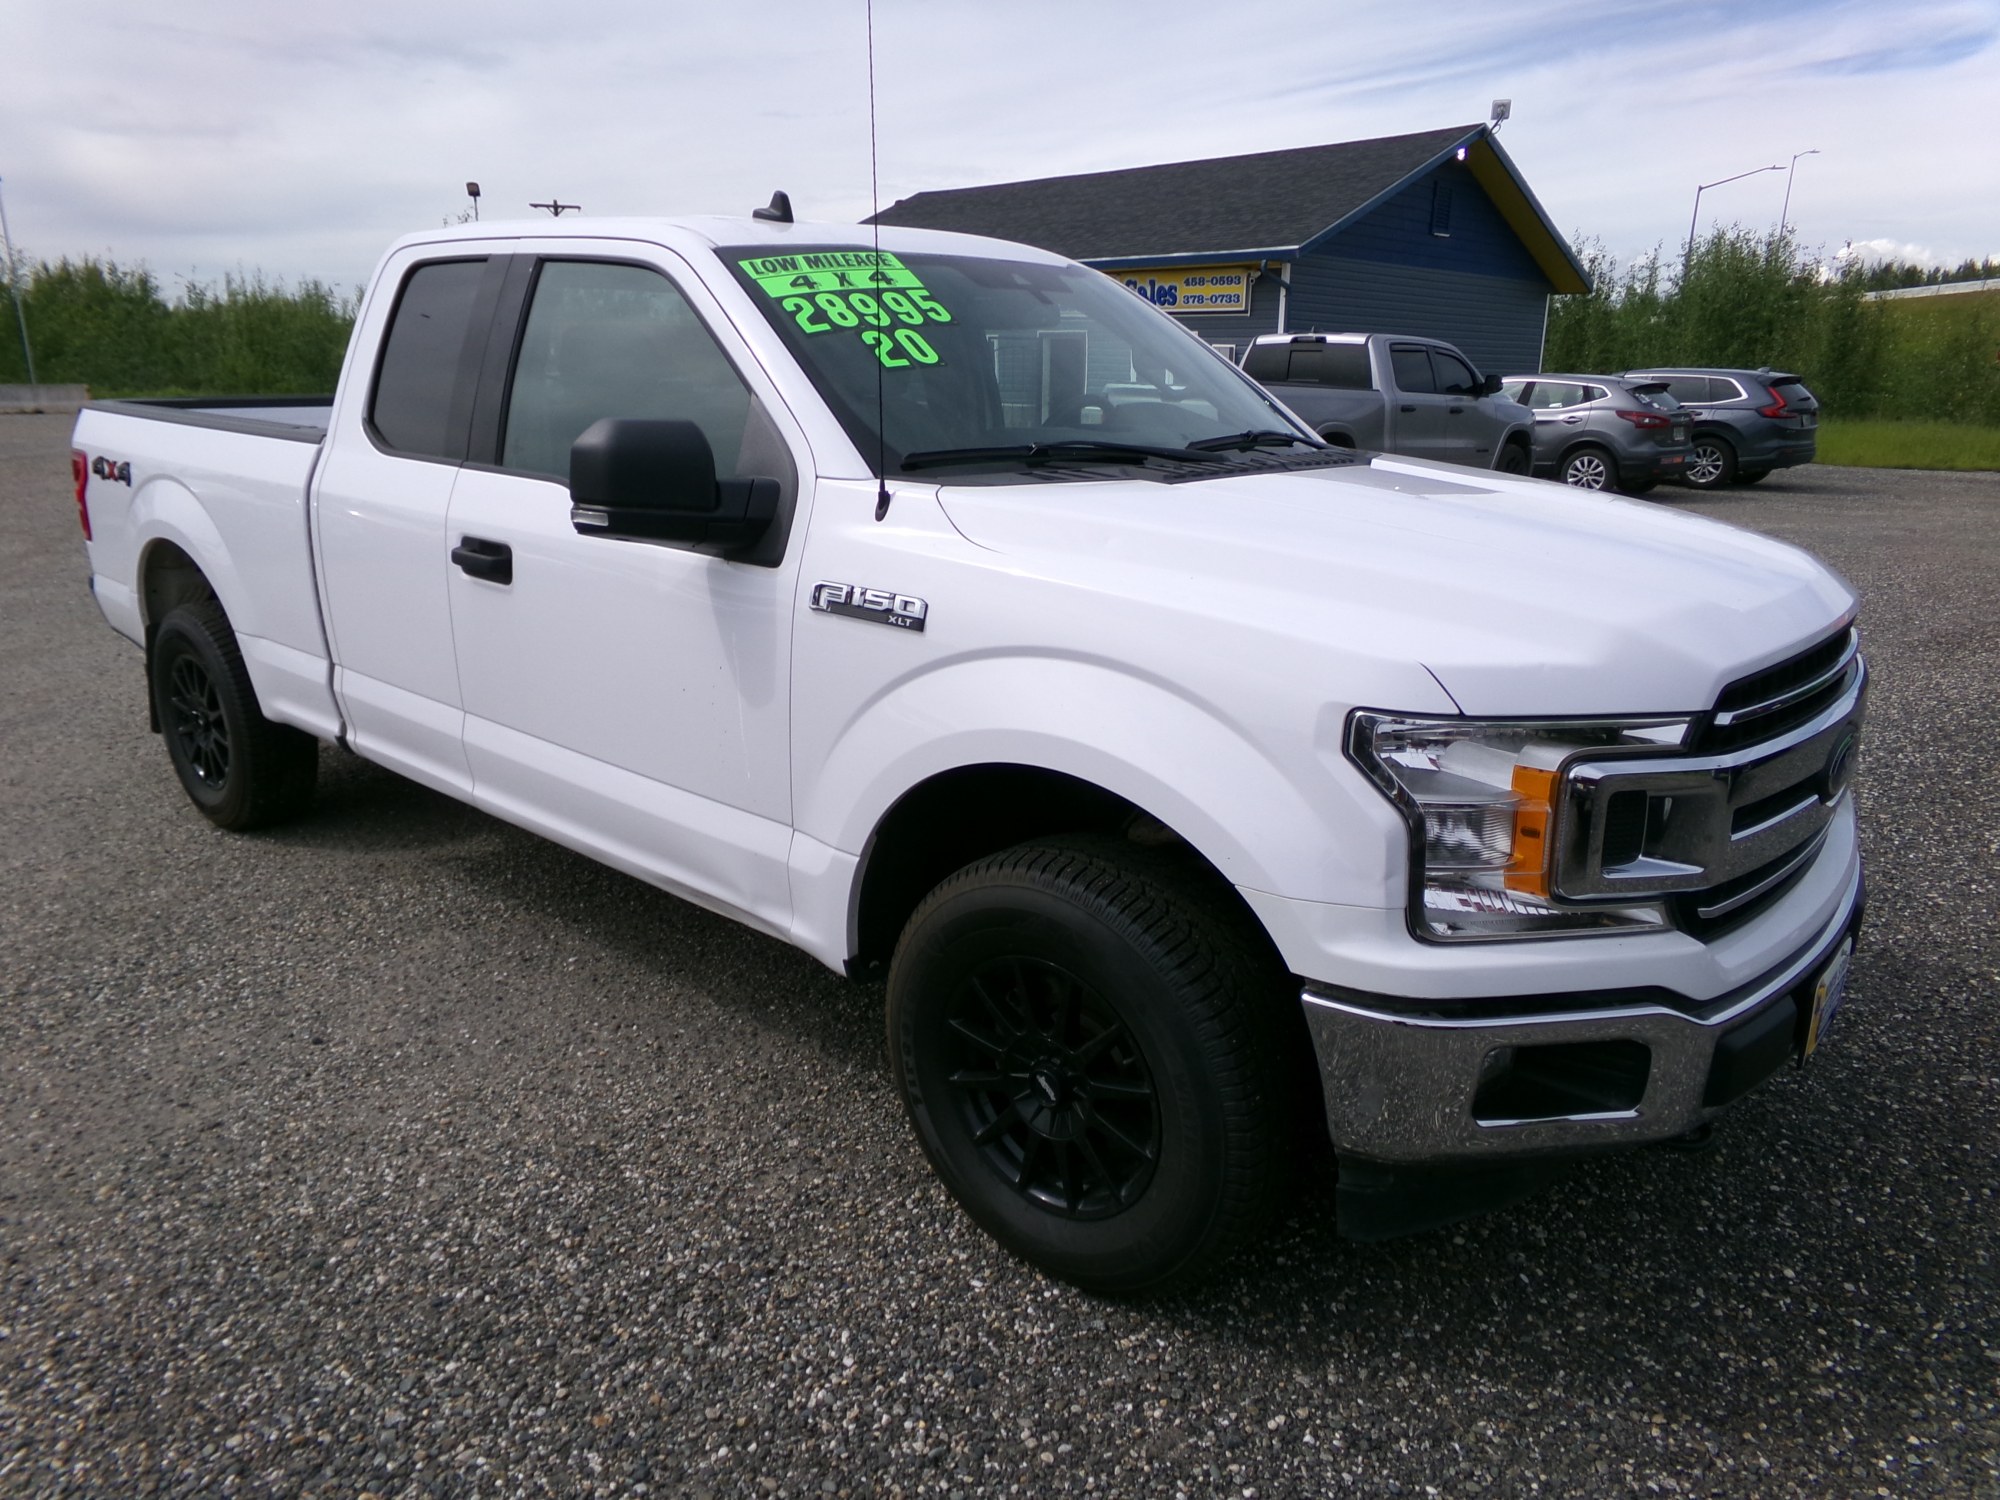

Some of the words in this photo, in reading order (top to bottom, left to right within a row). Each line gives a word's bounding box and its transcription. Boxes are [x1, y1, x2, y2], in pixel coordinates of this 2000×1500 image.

[748, 256, 799, 275] LOW
[806, 252, 894, 270] MILEAGE
[782, 289, 952, 334] 28995
[861, 328, 939, 368] 20
[888, 615, 913, 627] XLT
